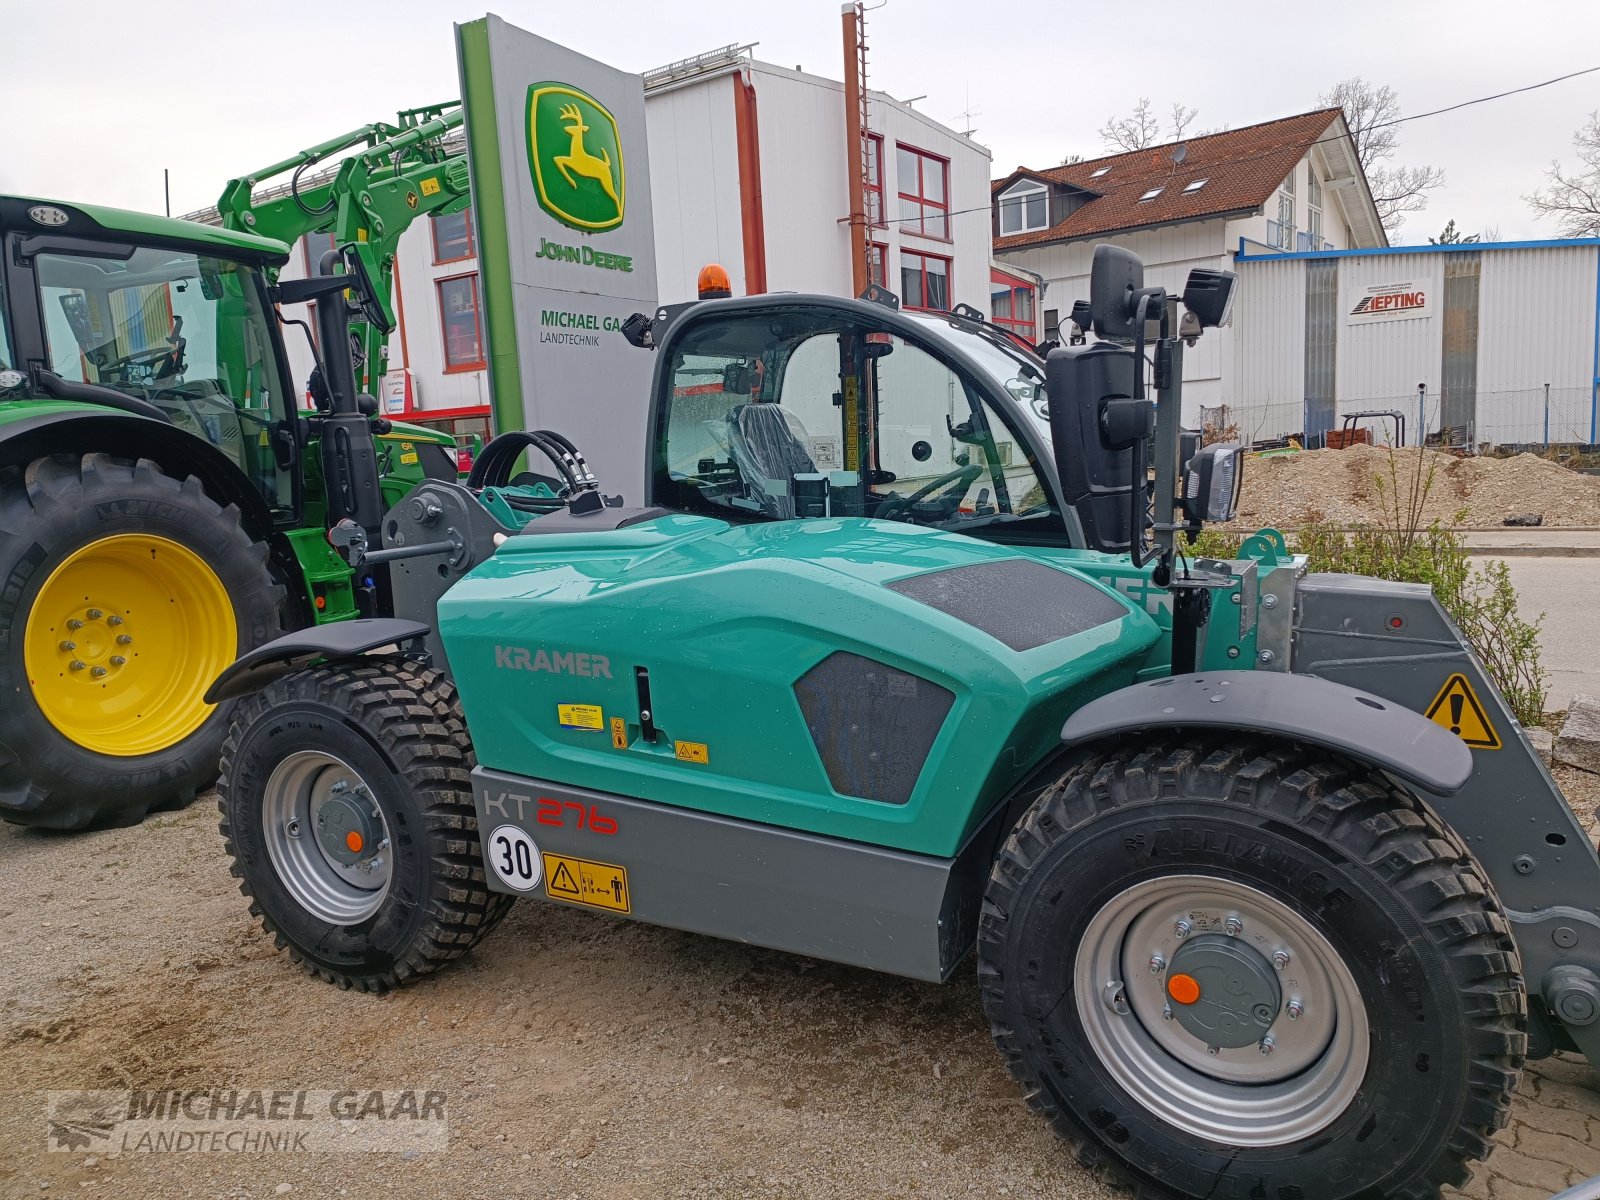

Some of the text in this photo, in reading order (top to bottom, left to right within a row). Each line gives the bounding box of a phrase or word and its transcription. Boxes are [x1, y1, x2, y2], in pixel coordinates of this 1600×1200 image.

[536, 237, 633, 273] JOHN DEERE
[541, 309, 624, 332] MICHAEL GA
[540, 331, 600, 347] LANDTECHNIK
[494, 645, 614, 679] KRAMER
[484, 790, 619, 836] KT 276
[496, 835, 533, 880] 30
